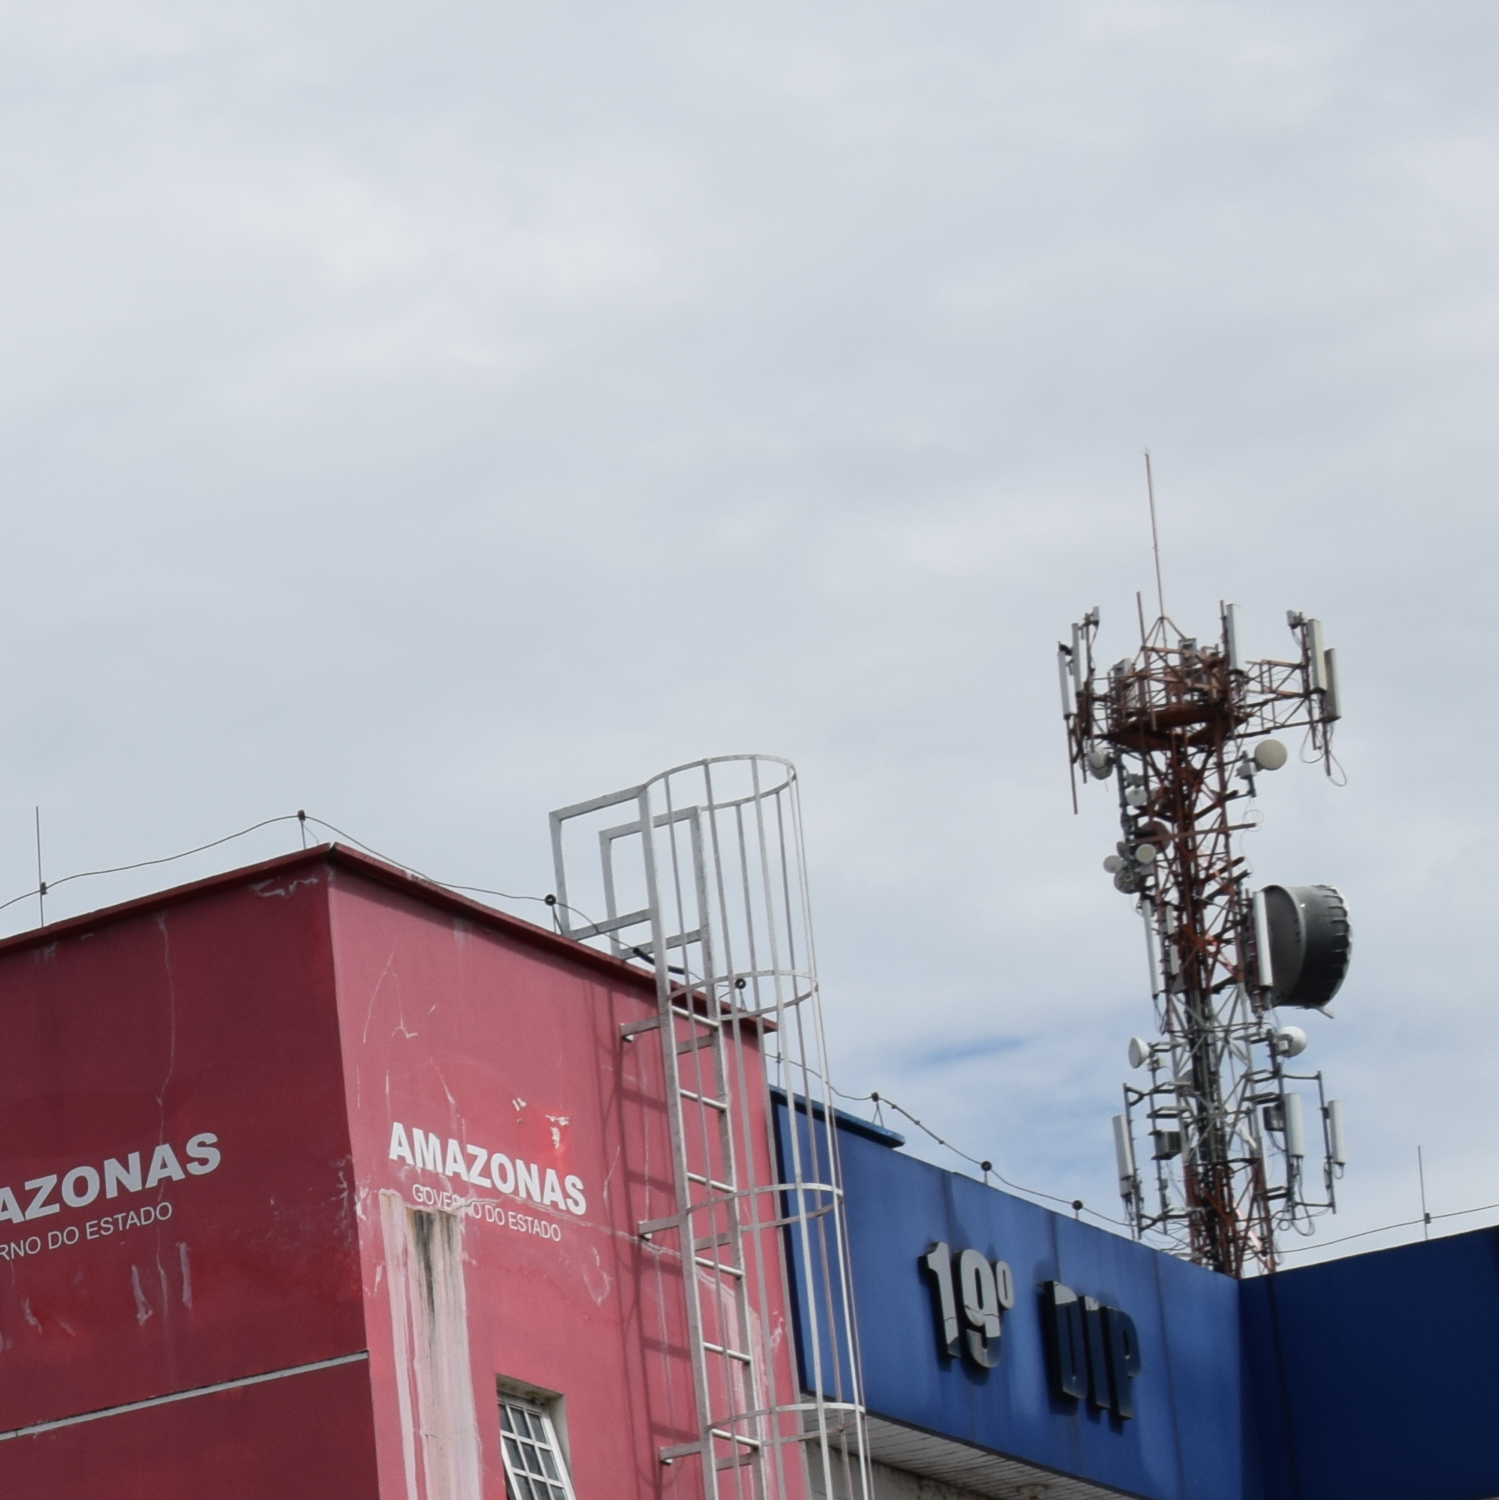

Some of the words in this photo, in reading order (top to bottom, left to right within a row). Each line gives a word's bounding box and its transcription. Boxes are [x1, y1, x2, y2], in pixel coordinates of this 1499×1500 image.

[389, 1121, 587, 1215] AMAZONAS
[47, 1226, 79, 1250] DO
[86, 1201, 173, 1240] ESTADO
[485, 1204, 505, 1226] DO
[508, 1211, 561, 1242] ESTADO
[919, 1241, 1015, 1369] 19º
[1039, 1280, 1141, 1420] DIP
